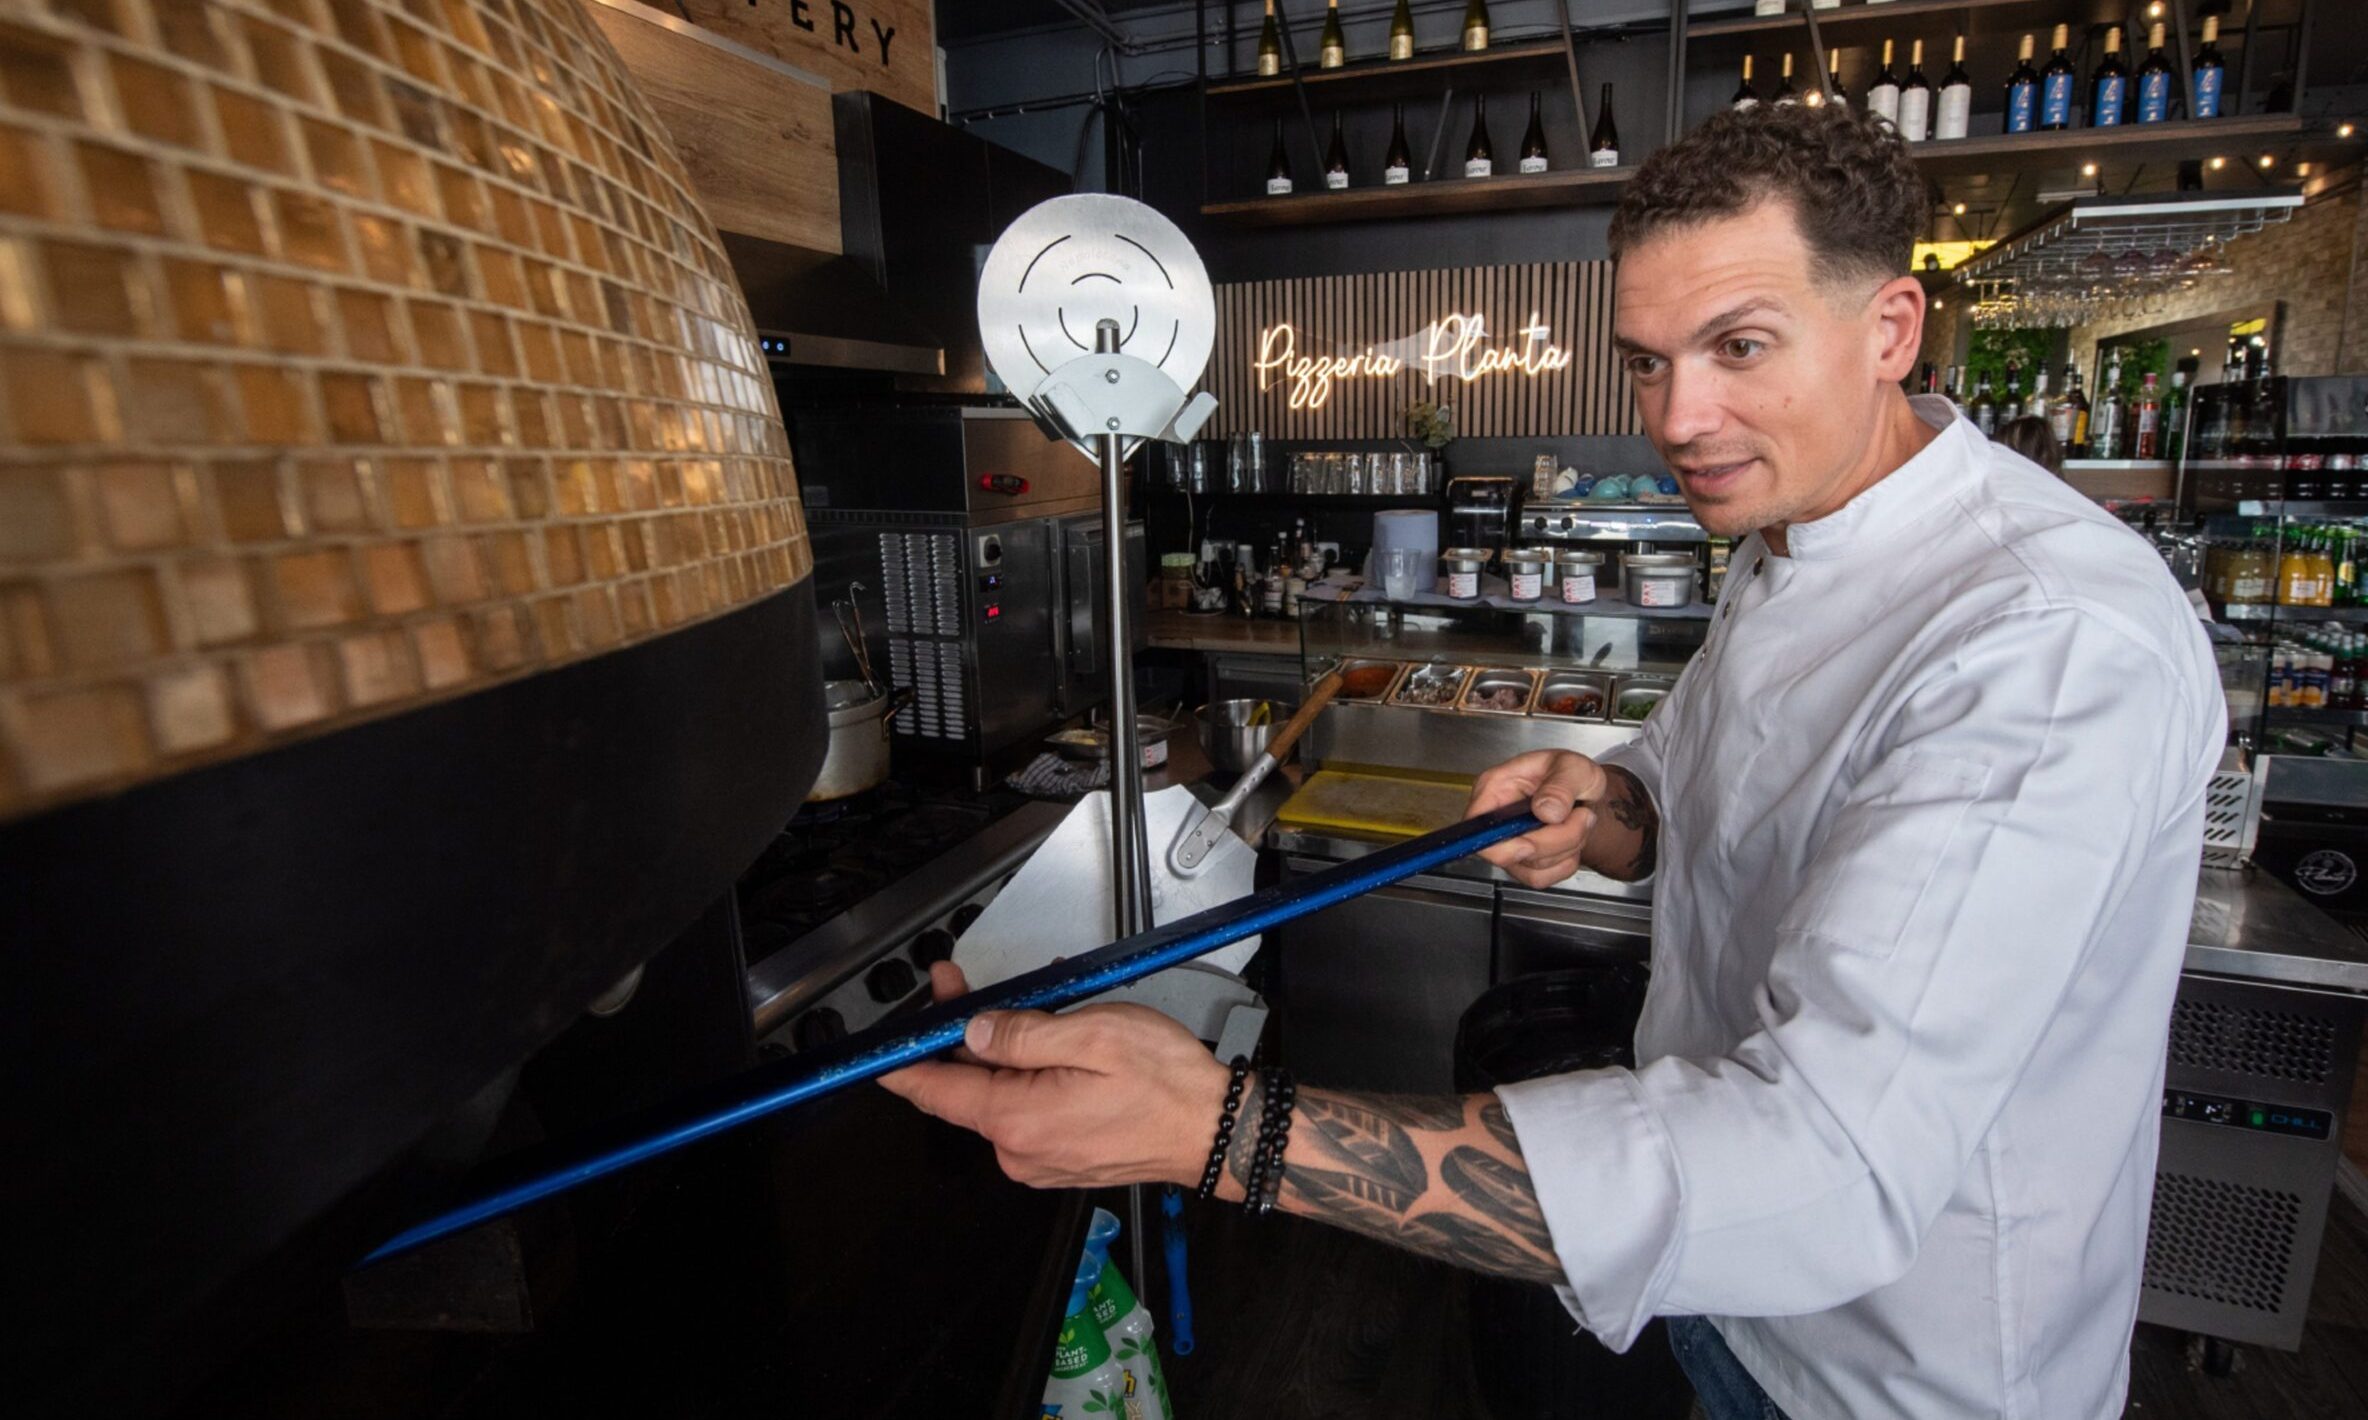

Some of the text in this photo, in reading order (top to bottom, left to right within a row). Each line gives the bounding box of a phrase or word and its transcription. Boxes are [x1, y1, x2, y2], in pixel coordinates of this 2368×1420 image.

[747, 0, 896, 67] ERY
[1254, 310, 1572, 409] Pizzeria Planta
